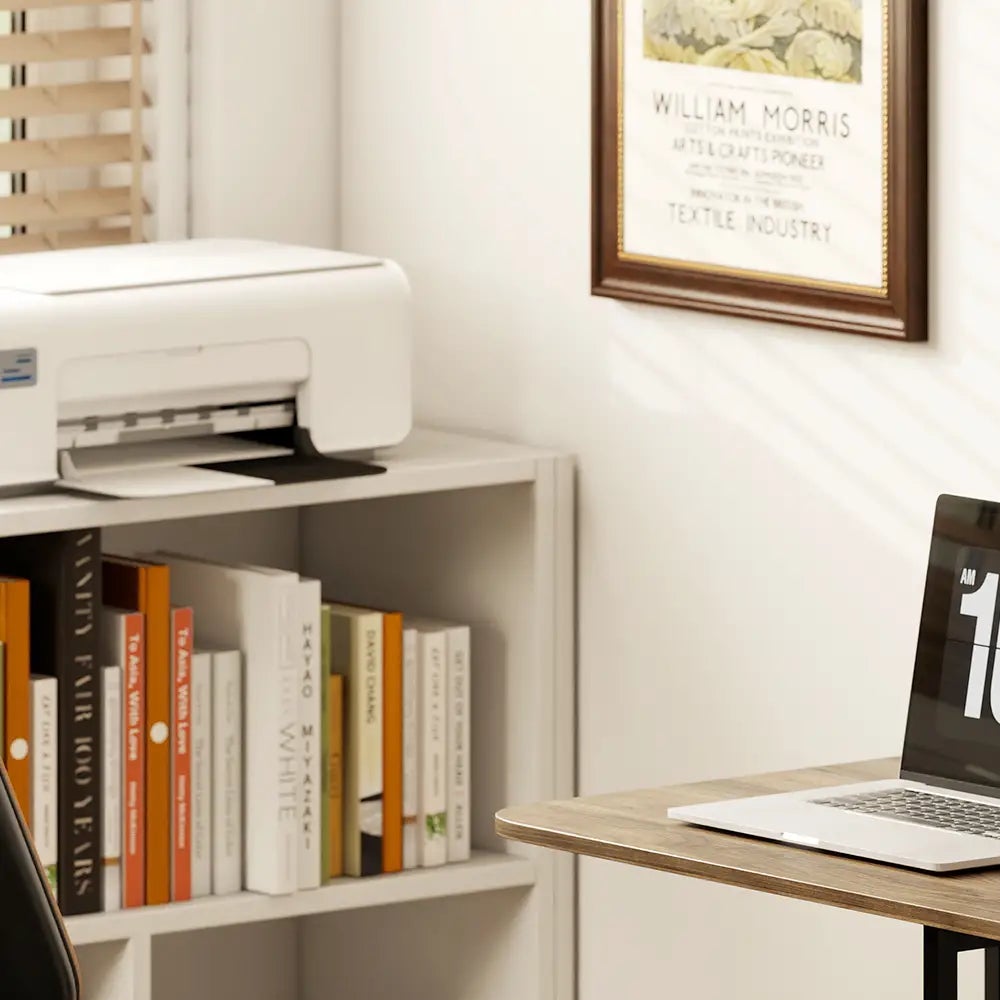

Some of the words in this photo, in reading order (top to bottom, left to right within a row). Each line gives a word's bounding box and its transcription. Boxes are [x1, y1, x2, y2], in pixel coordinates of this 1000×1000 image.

[653, 92, 746, 126] WILLIAM
[763, 105, 850, 138] MORRIS
[673, 138, 704, 155] ARTS
[719, 143, 768, 164] CRAFTS
[772, 148, 824, 170] PIONEER
[668, 202, 736, 230] TEXTILE
[747, 213, 832, 243] INDUSTRY
[74, 533, 95, 637] VANITY
[960, 567, 976, 586] AM
[127, 634, 140, 655] To
[177, 628, 189, 648] To
[365, 629, 376, 673] DAVID
[127, 658, 140, 688] Asia,
[177, 650, 189, 682] Asia,
[302, 623, 313, 698] HAYAO
[74, 655, 95, 721] FAIR
[127, 691, 140, 724] With
[177, 685, 189, 721] With
[365, 675, 376, 724] CHANG
[127, 728, 140, 761] Love
[177, 723, 189, 754] Love
[74, 737, 95, 786] 100
[279, 723, 297, 823] WHITE
[302, 724, 314, 850] MIYAZAKI
[74, 797, 95, 897] YEARS
